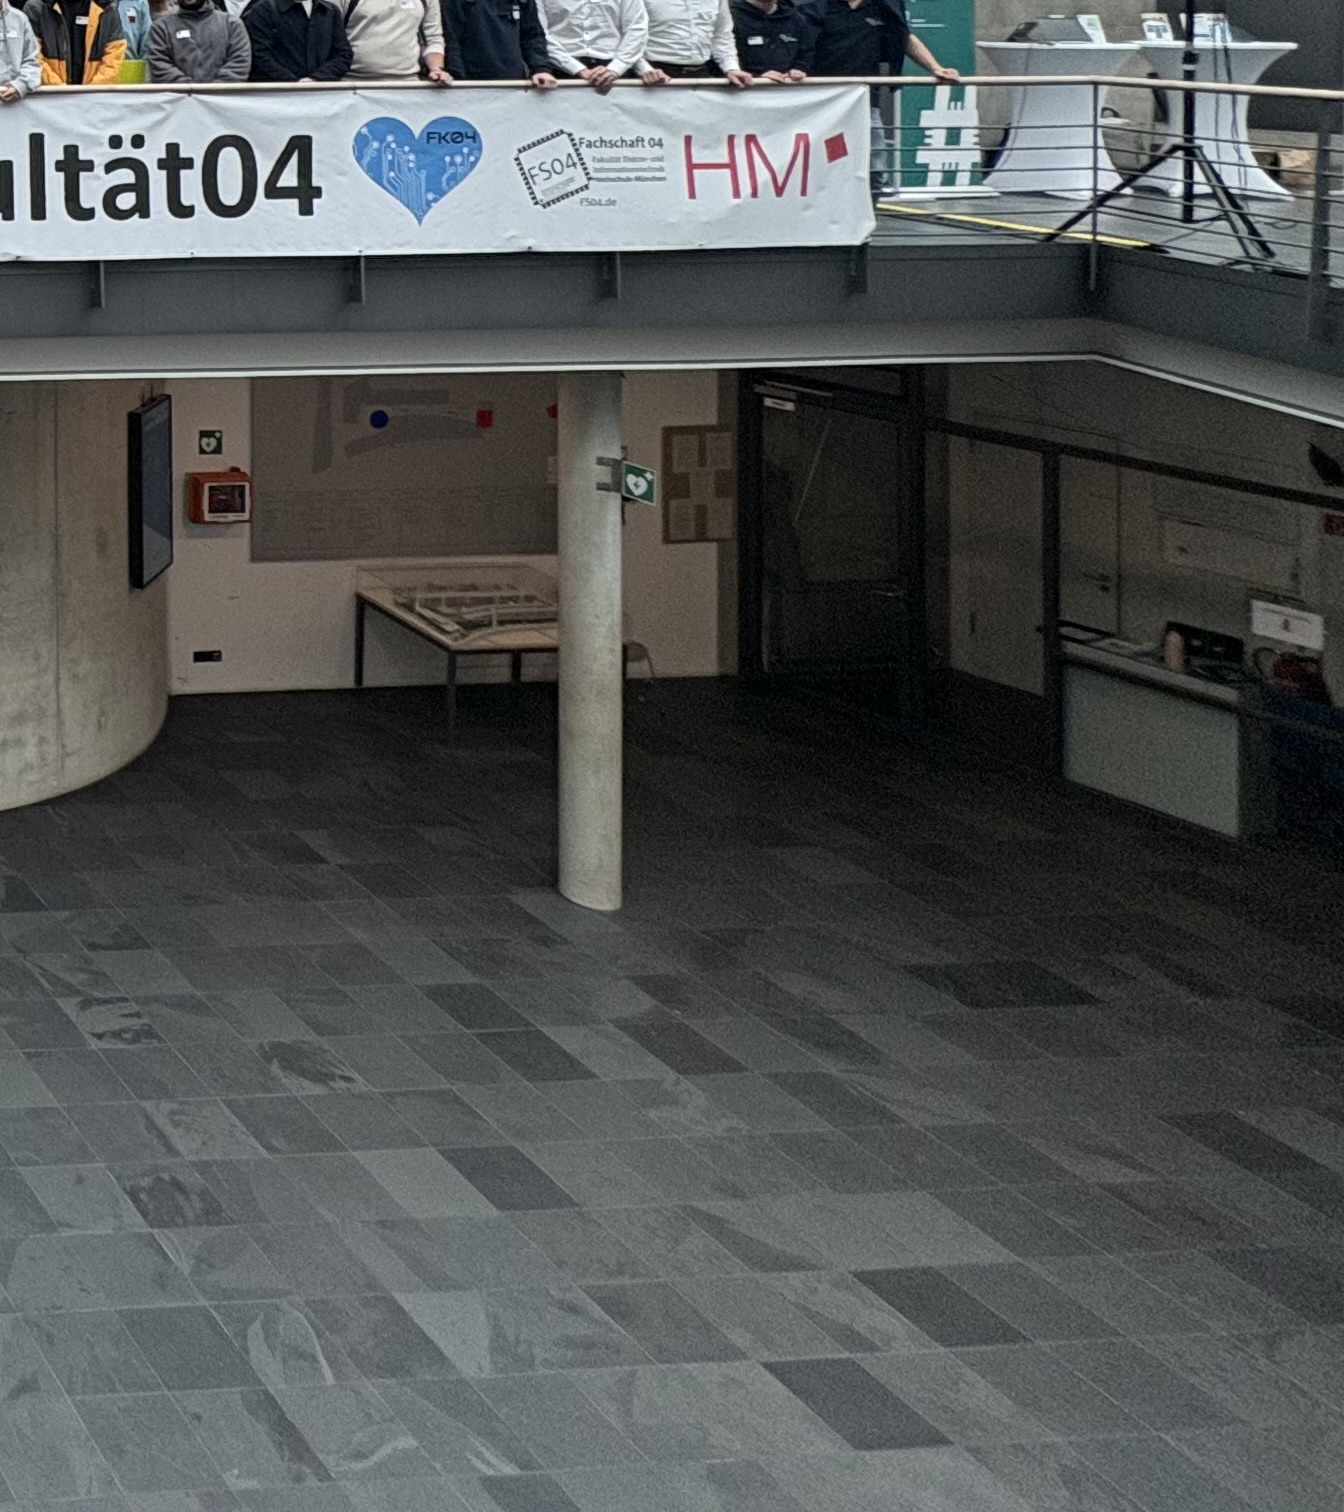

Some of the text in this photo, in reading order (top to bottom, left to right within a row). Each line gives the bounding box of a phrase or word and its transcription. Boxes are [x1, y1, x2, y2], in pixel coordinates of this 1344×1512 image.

[425, 131, 477, 144] FK04
[579, 137, 664, 149] Fachschaft 04
[527, 152, 578, 186] FS04
[682, 131, 812, 201] HM
